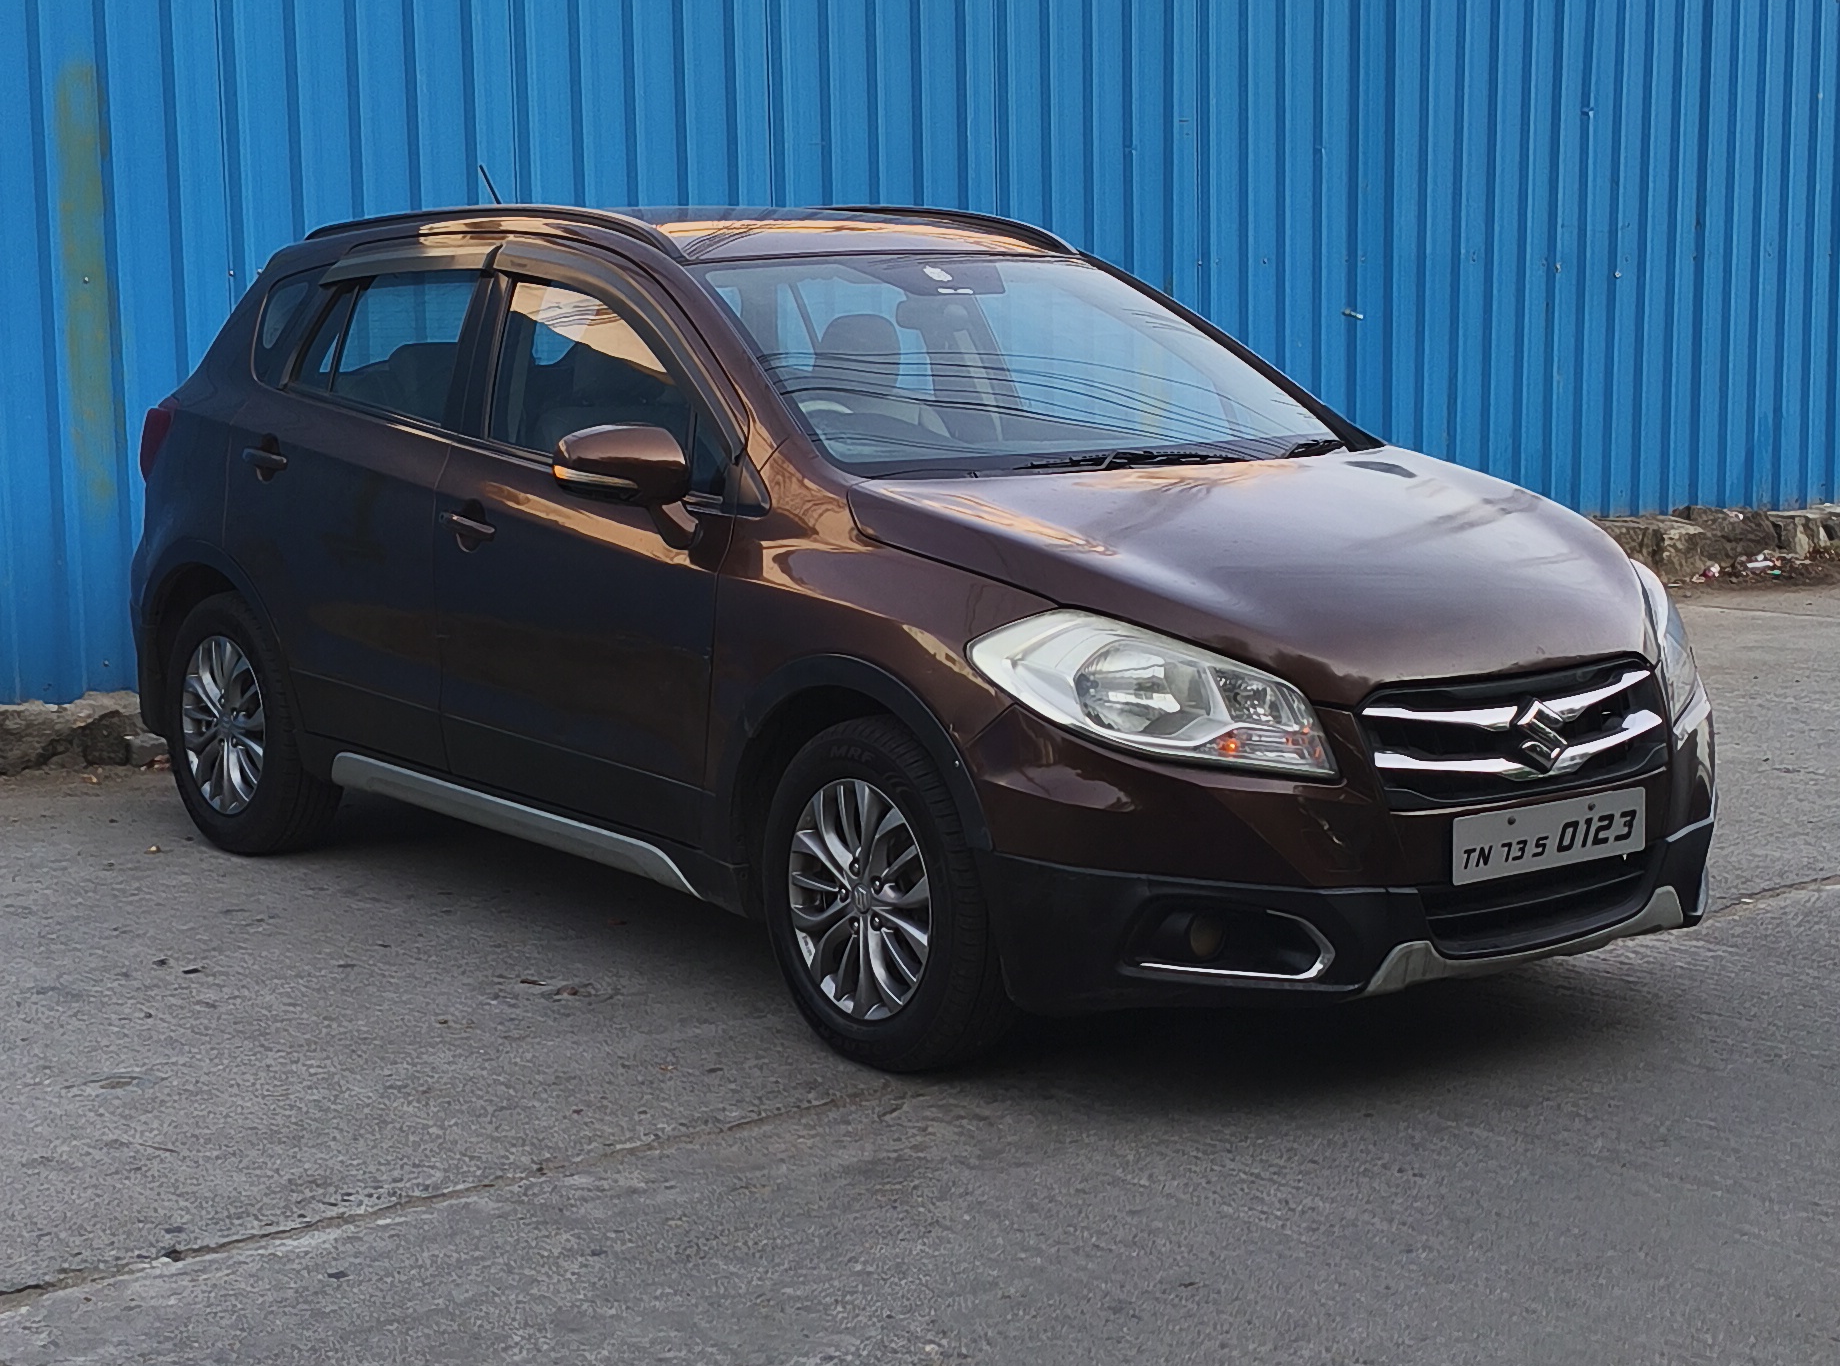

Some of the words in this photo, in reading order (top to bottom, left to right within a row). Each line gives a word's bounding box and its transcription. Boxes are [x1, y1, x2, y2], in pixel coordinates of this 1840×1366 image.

[829, 745, 876, 764] MRF
[1463, 844, 1493, 870] TN
[1556, 808, 1637, 853] 0123
